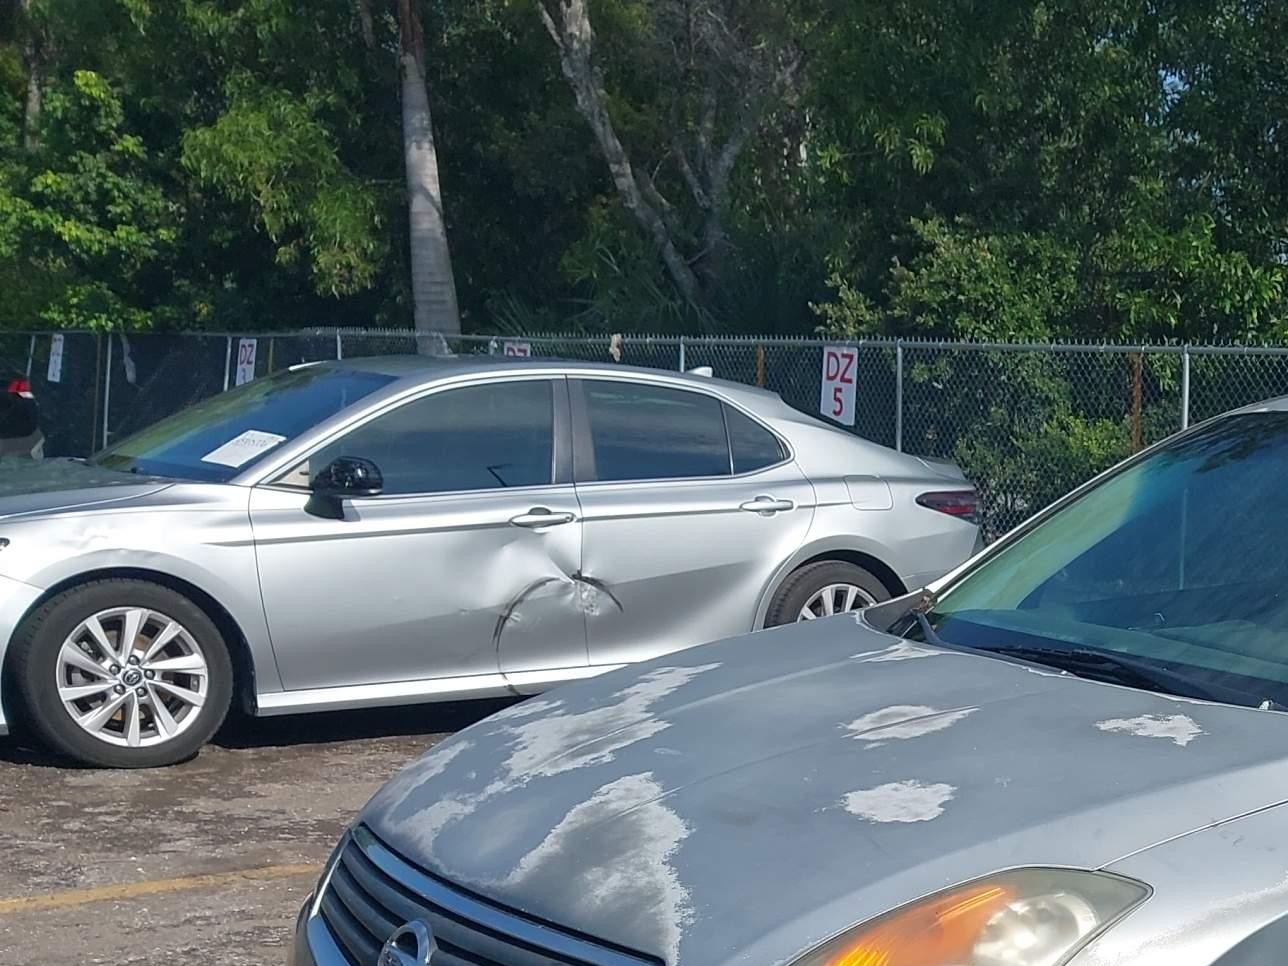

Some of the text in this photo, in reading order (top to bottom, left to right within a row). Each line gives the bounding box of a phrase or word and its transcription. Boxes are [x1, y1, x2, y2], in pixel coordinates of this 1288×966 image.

[240, 344, 254, 366] DZ
[826, 351, 854, 384] DZ
[832, 387, 844, 416] 5
